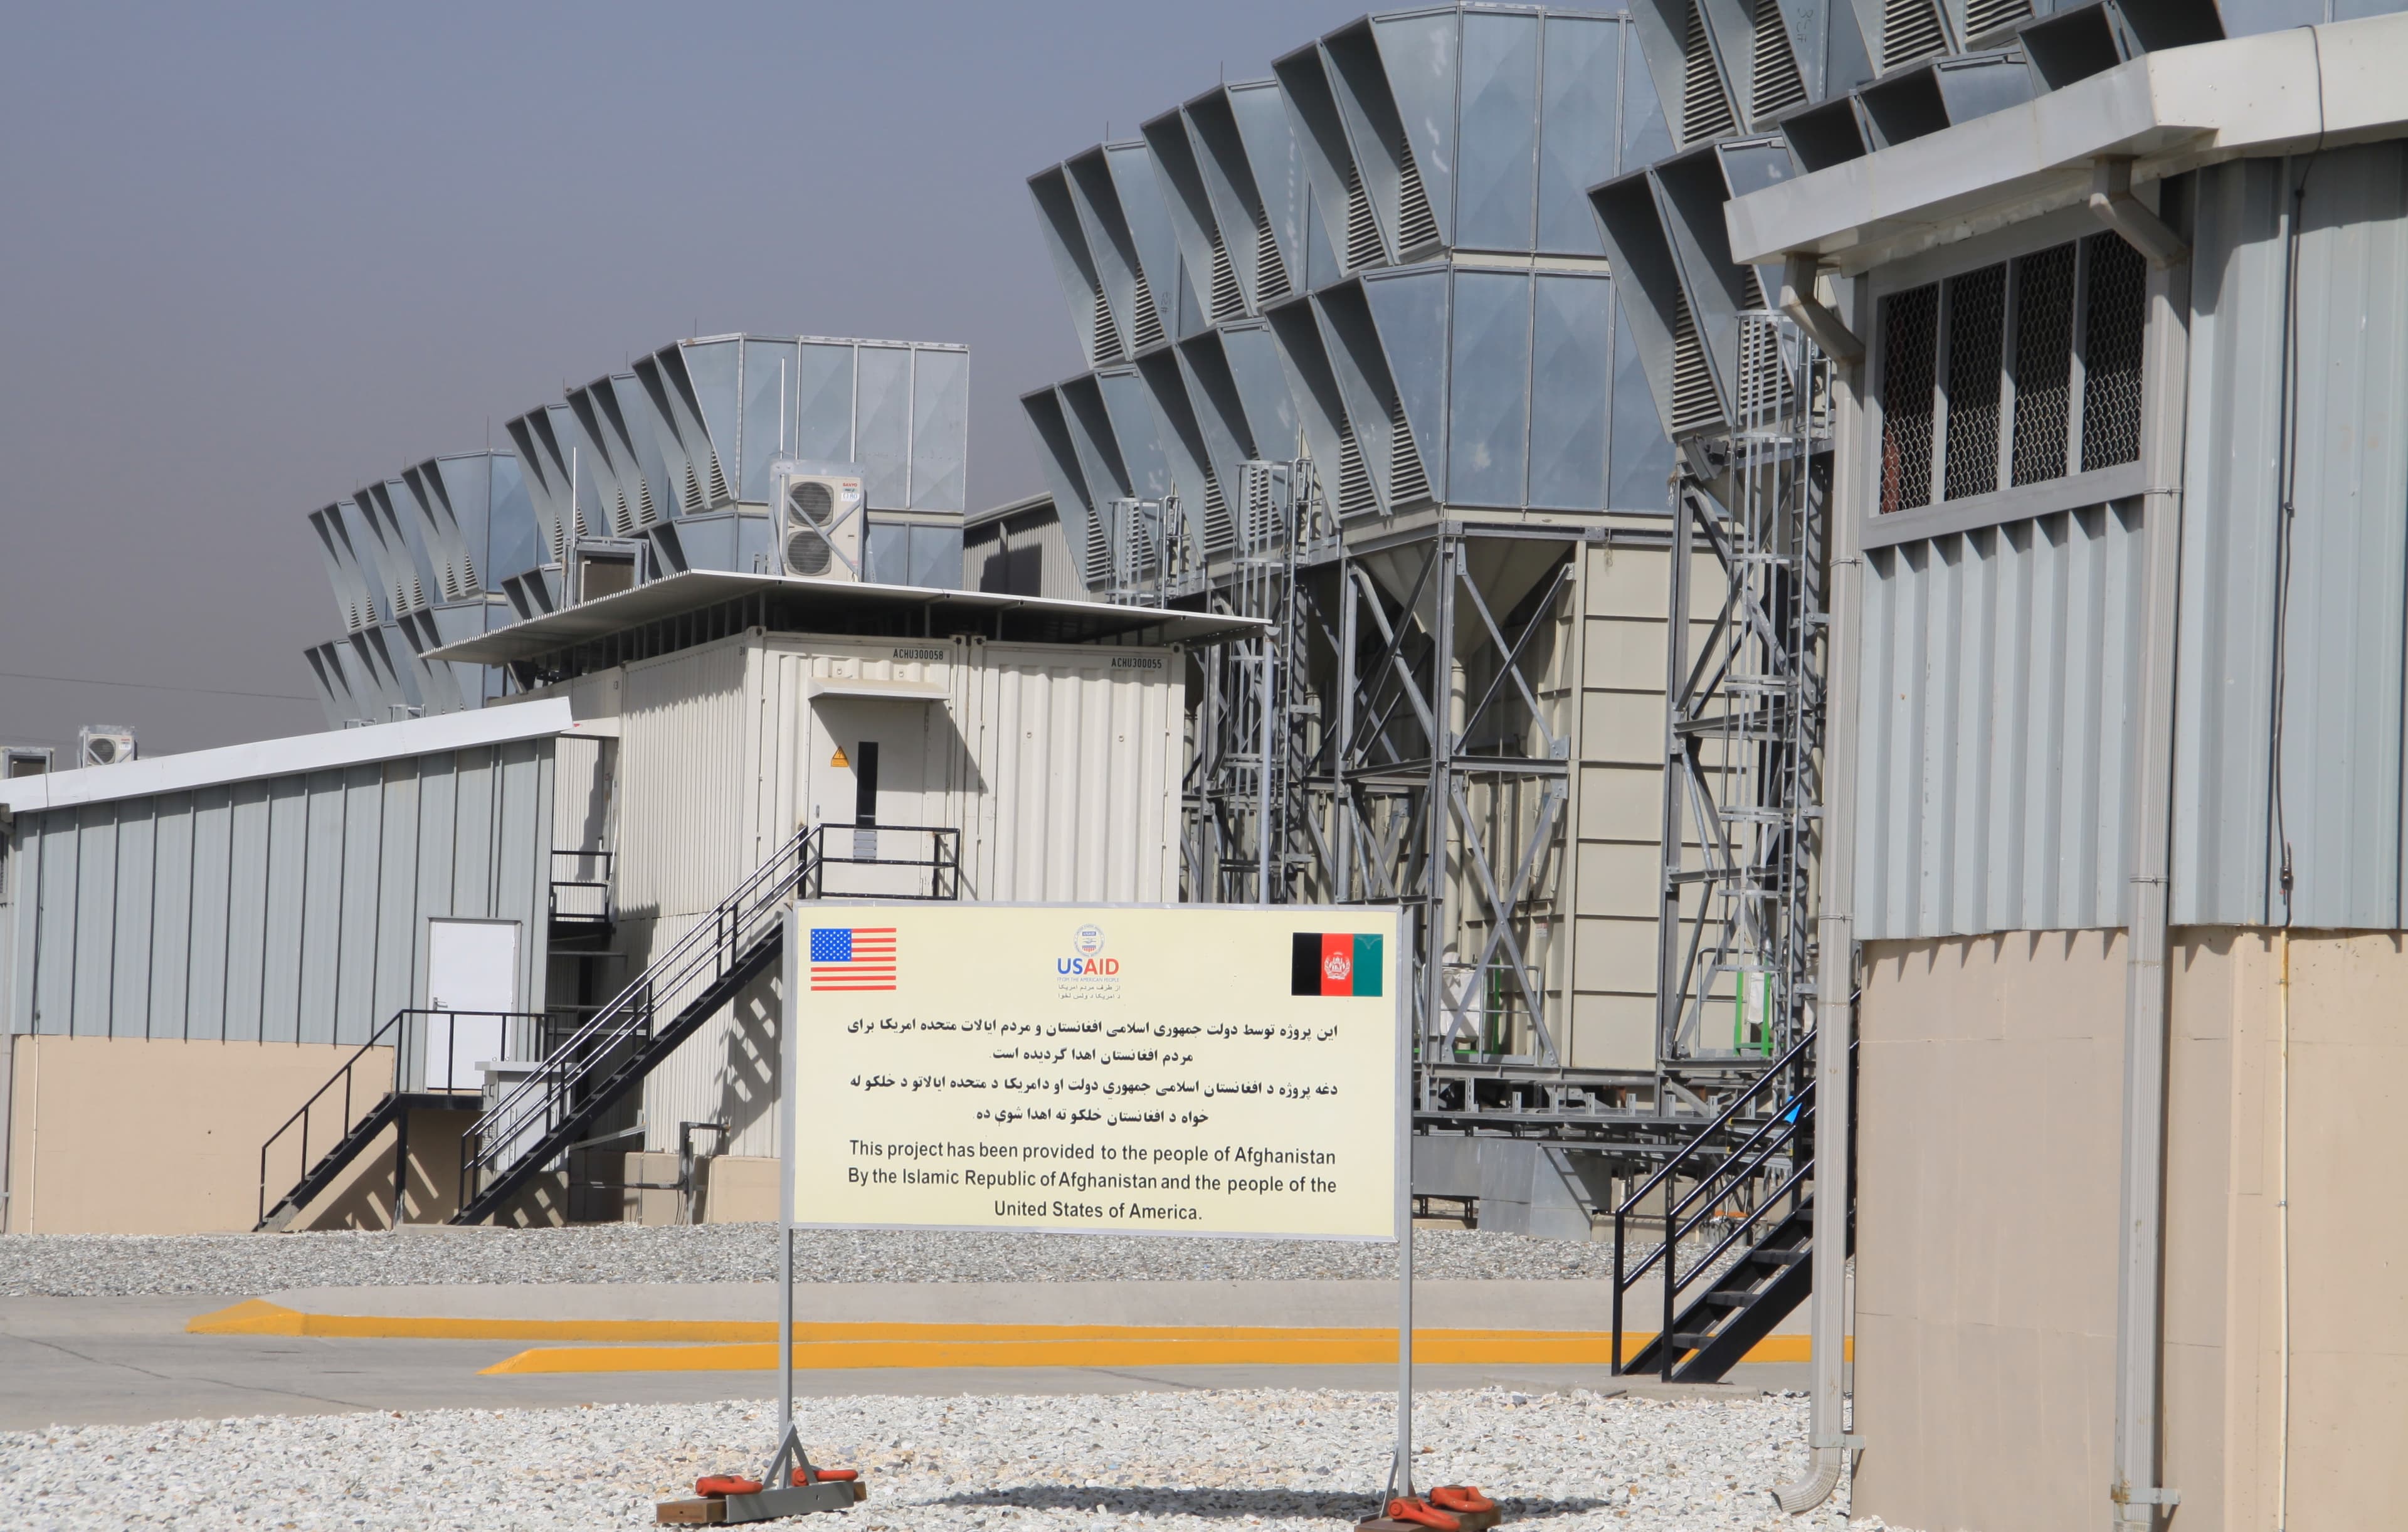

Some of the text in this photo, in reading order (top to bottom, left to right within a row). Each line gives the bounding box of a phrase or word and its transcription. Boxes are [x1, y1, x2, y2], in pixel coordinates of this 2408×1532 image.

[892, 648, 944, 660] ACHU300058
[1111, 657, 1162, 668] ACHU300055
[1057, 958, 1119, 975] USAID
[847, 1018, 1338, 1042] این پروژه توسط دولت جمهوری اسلامی افغانستان و مردم ایالات متحده امریکا برای
[1023, 1047, 1067, 1064] گردیده
[1071, 1048, 1096, 1060] اهدا
[1101, 1049, 1158, 1065] افغانستان
[1162, 1052, 1193, 1067] مردم
[850, 1074, 861, 1087] له
[864, 1074, 895, 1092] خلکو
[900, 1077, 908, 1087] د
[911, 1075, 946, 1092] ایالاتو
[950, 1078, 987, 1089] متحده
[991, 1079, 998, 1089] د
[1053, 1078, 1064, 1095] او
[1068, 1078, 1099, 1095] دولت
[1203, 1080, 1262, 1098] افغانستان
[1315, 1082, 1338, 1096] دغه
[1267, 1084, 1274, 1095] د
[1279, 1082, 1311, 1100] پروژه
[1027, 1107, 1052, 1120] اهدا
[1055, 1107, 1067, 1121] ته
[1070, 1107, 1102, 1125] خلکو
[1107, 1109, 1164, 1127] افغانستان
[1169, 1112, 1176, 1123] د
[1181, 1109, 1209, 1128] خواه
[849, 1139, 1336, 1167] This project has been provided to the people of Afghanistan
[848, 1167, 1336, 1195] By the Islamic Republic of Afghanistan and the people of the
[995, 1200, 1202, 1220] United States of America.
